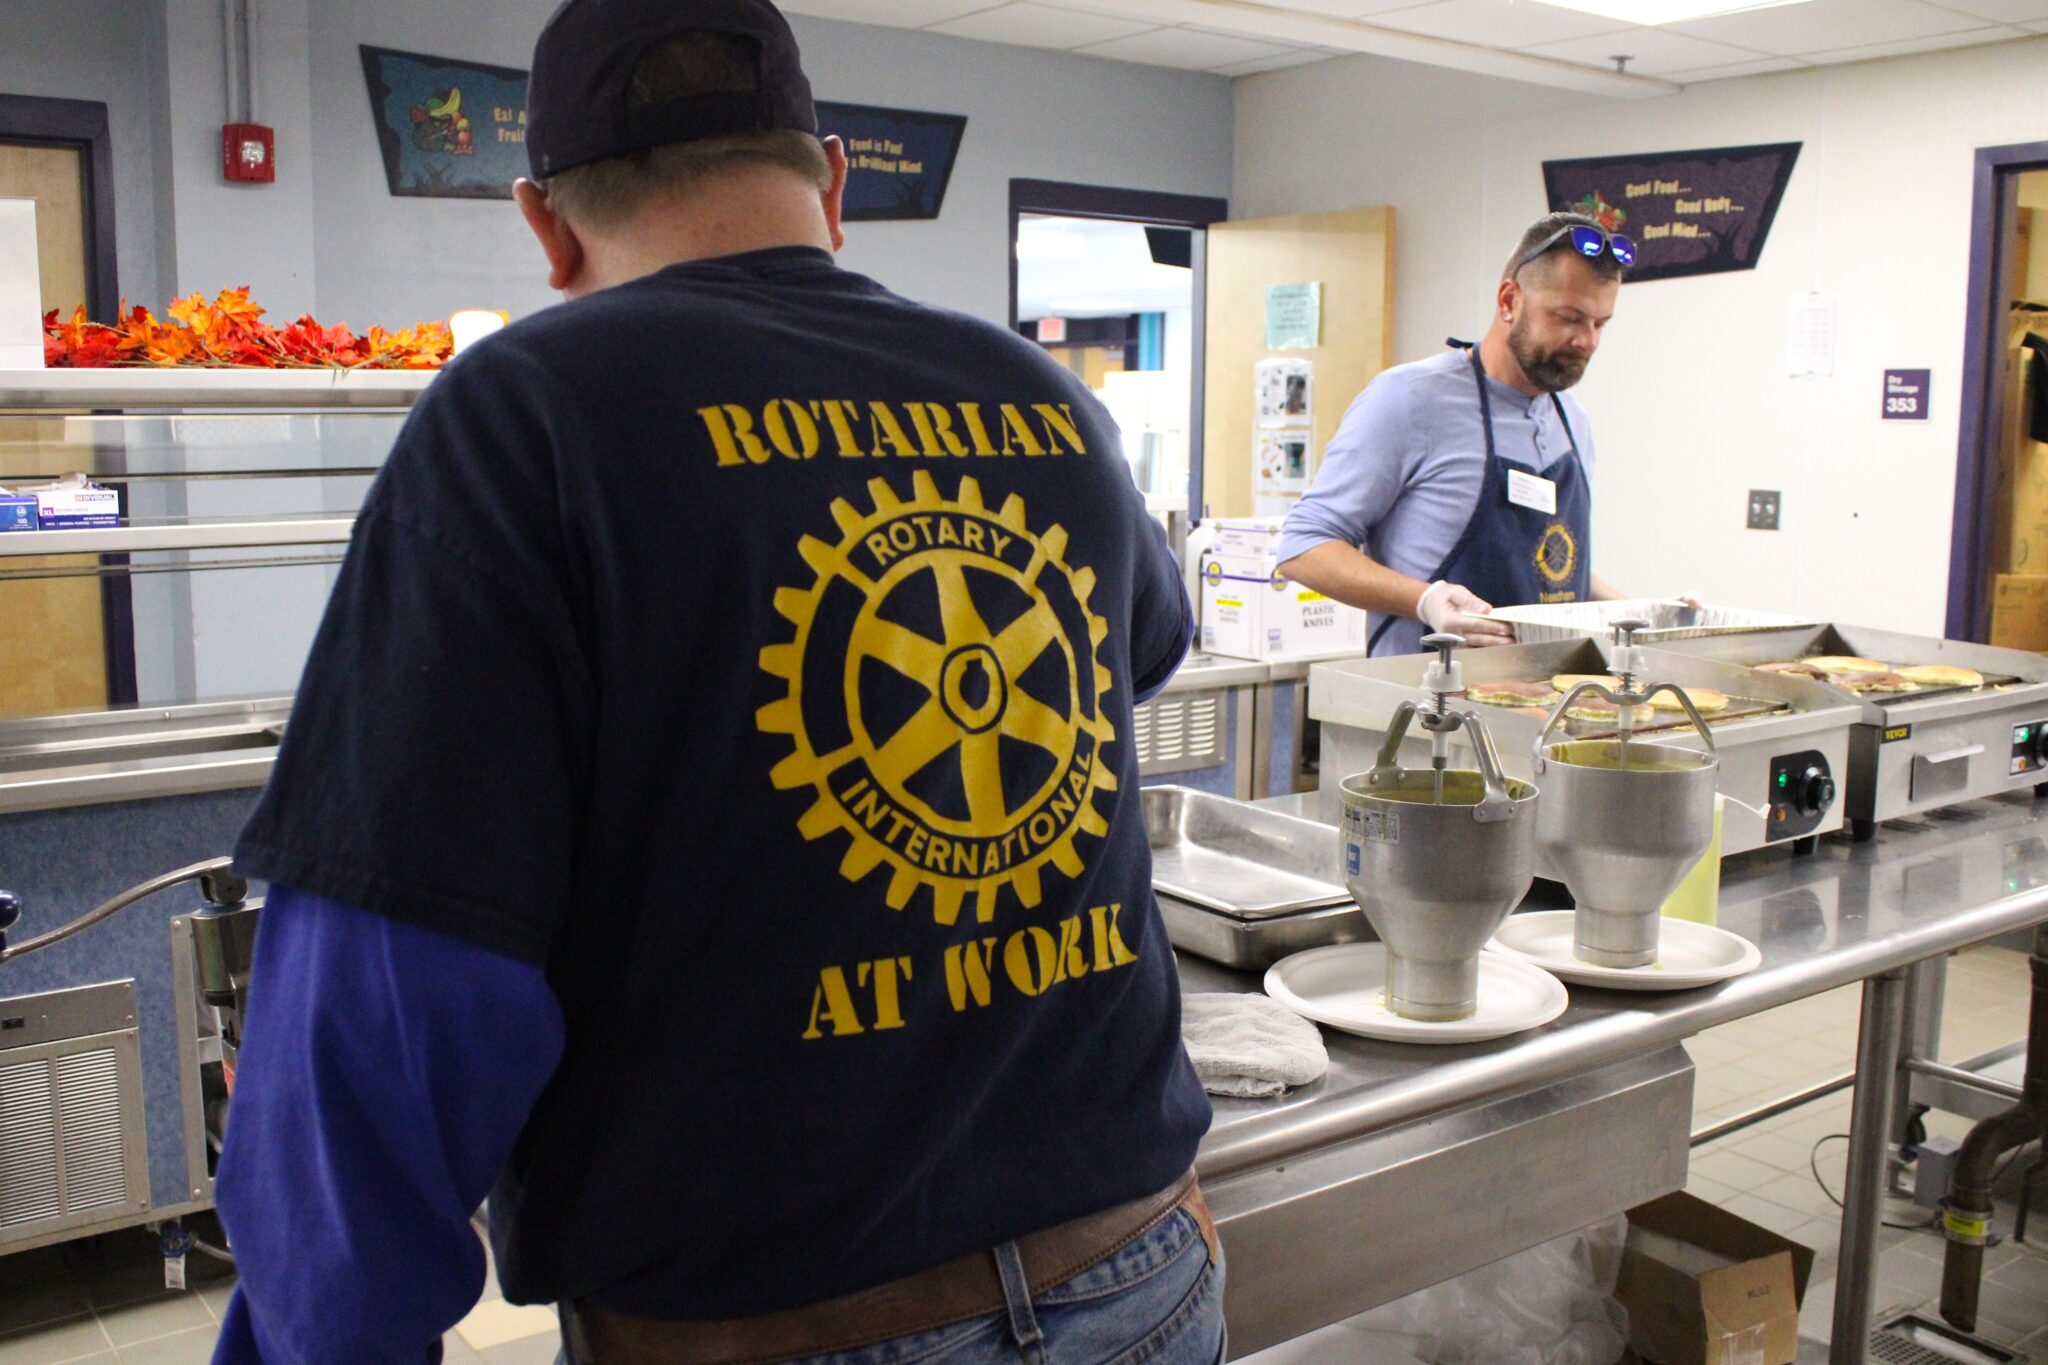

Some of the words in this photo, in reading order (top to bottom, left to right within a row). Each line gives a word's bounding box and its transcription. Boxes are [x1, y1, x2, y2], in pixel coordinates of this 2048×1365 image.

[1625, 180, 1651, 198] Good
[1675, 198, 1702, 214] Good
[1643, 222, 1670, 240] Good
[1886, 397, 1918, 413] 353
[696, 398, 1088, 467] ROTARIAN
[865, 516, 1012, 567] ROTARY
[839, 751, 1092, 876] INTERNATIONAL
[801, 955, 914, 1040] AT
[943, 902, 1139, 1012] WORK
